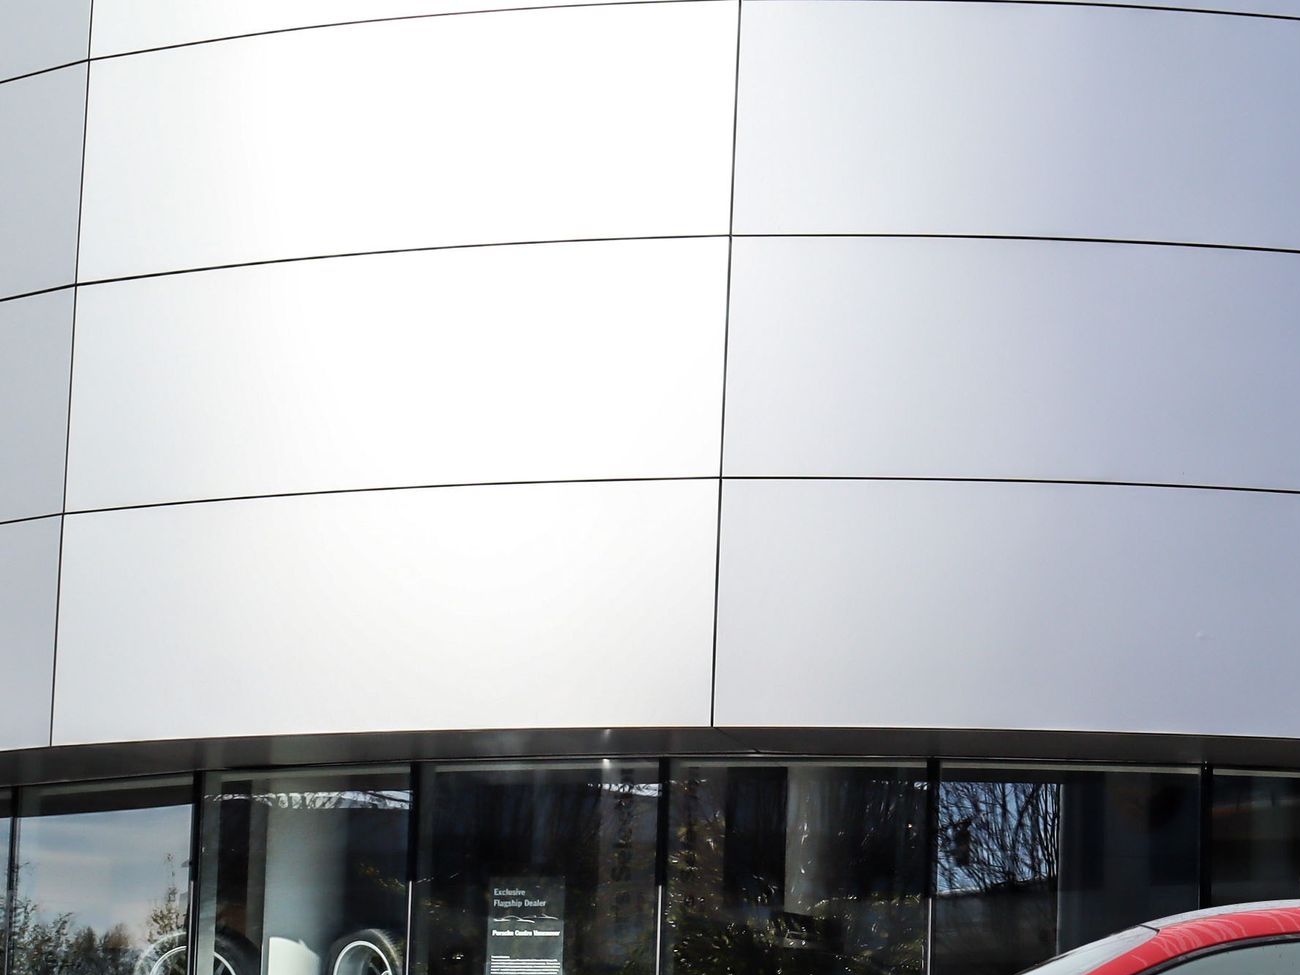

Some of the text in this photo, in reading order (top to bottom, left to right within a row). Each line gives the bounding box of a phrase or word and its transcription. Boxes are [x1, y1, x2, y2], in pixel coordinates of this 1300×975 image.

[493, 888, 526, 896] Exclusive
[493, 899, 546, 908] Flagship Dealer
